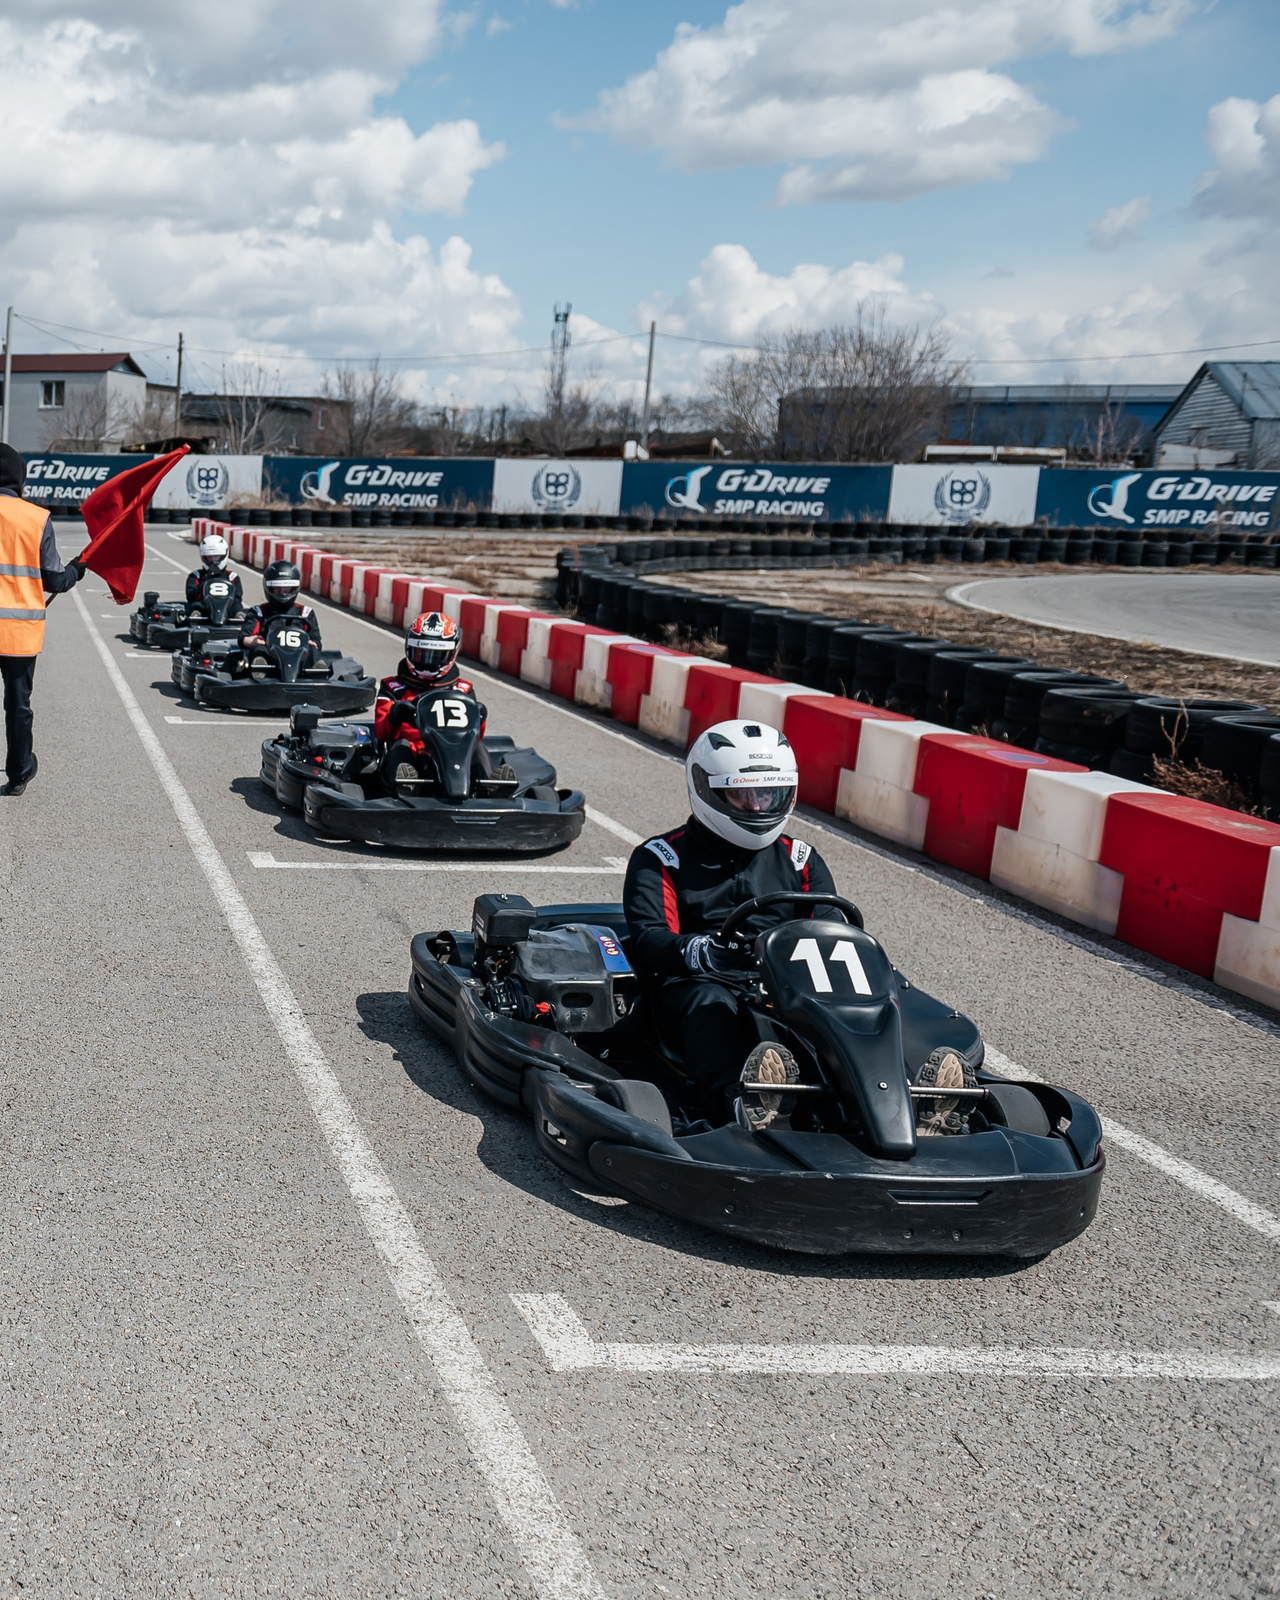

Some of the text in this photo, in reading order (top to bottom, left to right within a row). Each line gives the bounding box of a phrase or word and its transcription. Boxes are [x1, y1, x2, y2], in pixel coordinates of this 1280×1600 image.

[23, 485, 96, 499] SMP RACIN
[342, 493, 439, 507] SMP RACING
[713, 499, 824, 516] SMP RACING
[1143, 509, 1270, 526] SMP RACING
[210, 582, 229, 596] 8
[277, 630, 301, 648] 16
[431, 699, 468, 728] 13
[790, 938, 873, 995] 11
